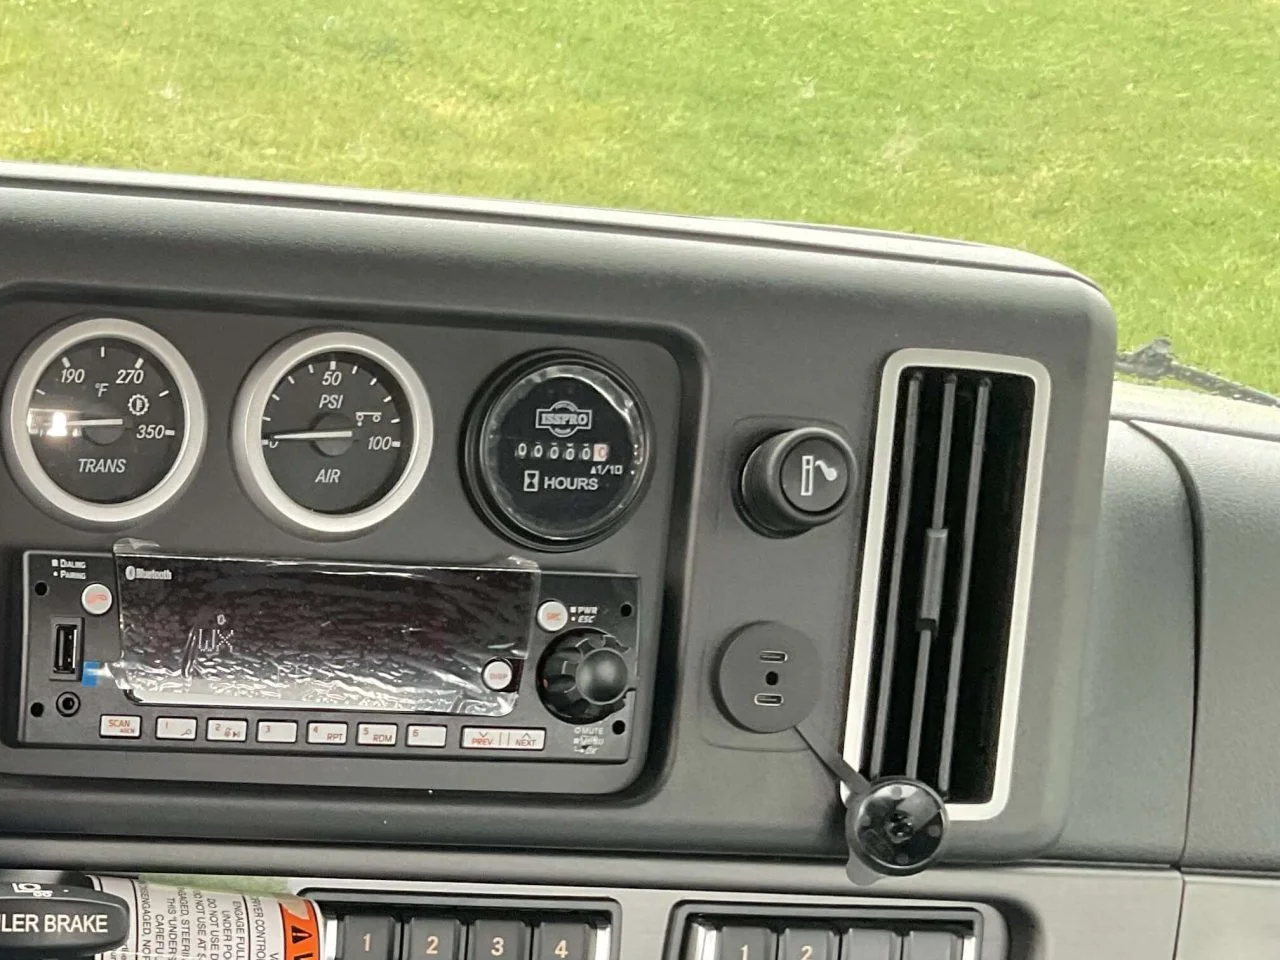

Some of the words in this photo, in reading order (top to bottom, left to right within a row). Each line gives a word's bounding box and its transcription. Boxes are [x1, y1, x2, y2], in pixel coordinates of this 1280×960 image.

[61, 369, 85, 383] 190
[116, 369, 144, 384] 270
[322, 371, 342, 386] 50
[319, 394, 343, 409] PSI
[541, 413, 587, 425] ISSPRO
[136, 425, 165, 439] 350
[368, 436, 391, 450] 100
[78, 458, 126, 473] TRANS
[315, 469, 340, 483] AIR
[544, 476, 598, 491] HOURS
[136, 568, 172, 580] Bluetooth
[109, 720, 130, 728] SCAN
[265, 725, 271, 733] 3
[363, 727, 369, 735] 5
[582, 727, 604, 735] MUTE
[327, 733, 342, 741] RPT
[373, 734, 392, 742] RDM
[472, 738, 492, 746] PREV
[516, 738, 536, 746] NEXT
[167, 899, 176, 914] THIS
[196, 900, 205, 914] NOT
[207, 899, 217, 908] DO
[44, 913, 108, 933] BRAKE
[210, 911, 219, 928] NOT
[233, 901, 245, 933] ENGAGE
[197, 917, 206, 936] USE
[222, 911, 232, 941] UNDER
[197, 938, 206, 951] AT
[210, 931, 219, 950] USE
[363, 934, 371, 952] 1
[426, 936, 439, 955] 2
[491, 937, 504, 957] 3
[236, 936, 245, 960] FULL
[555, 940, 569, 958] 4
